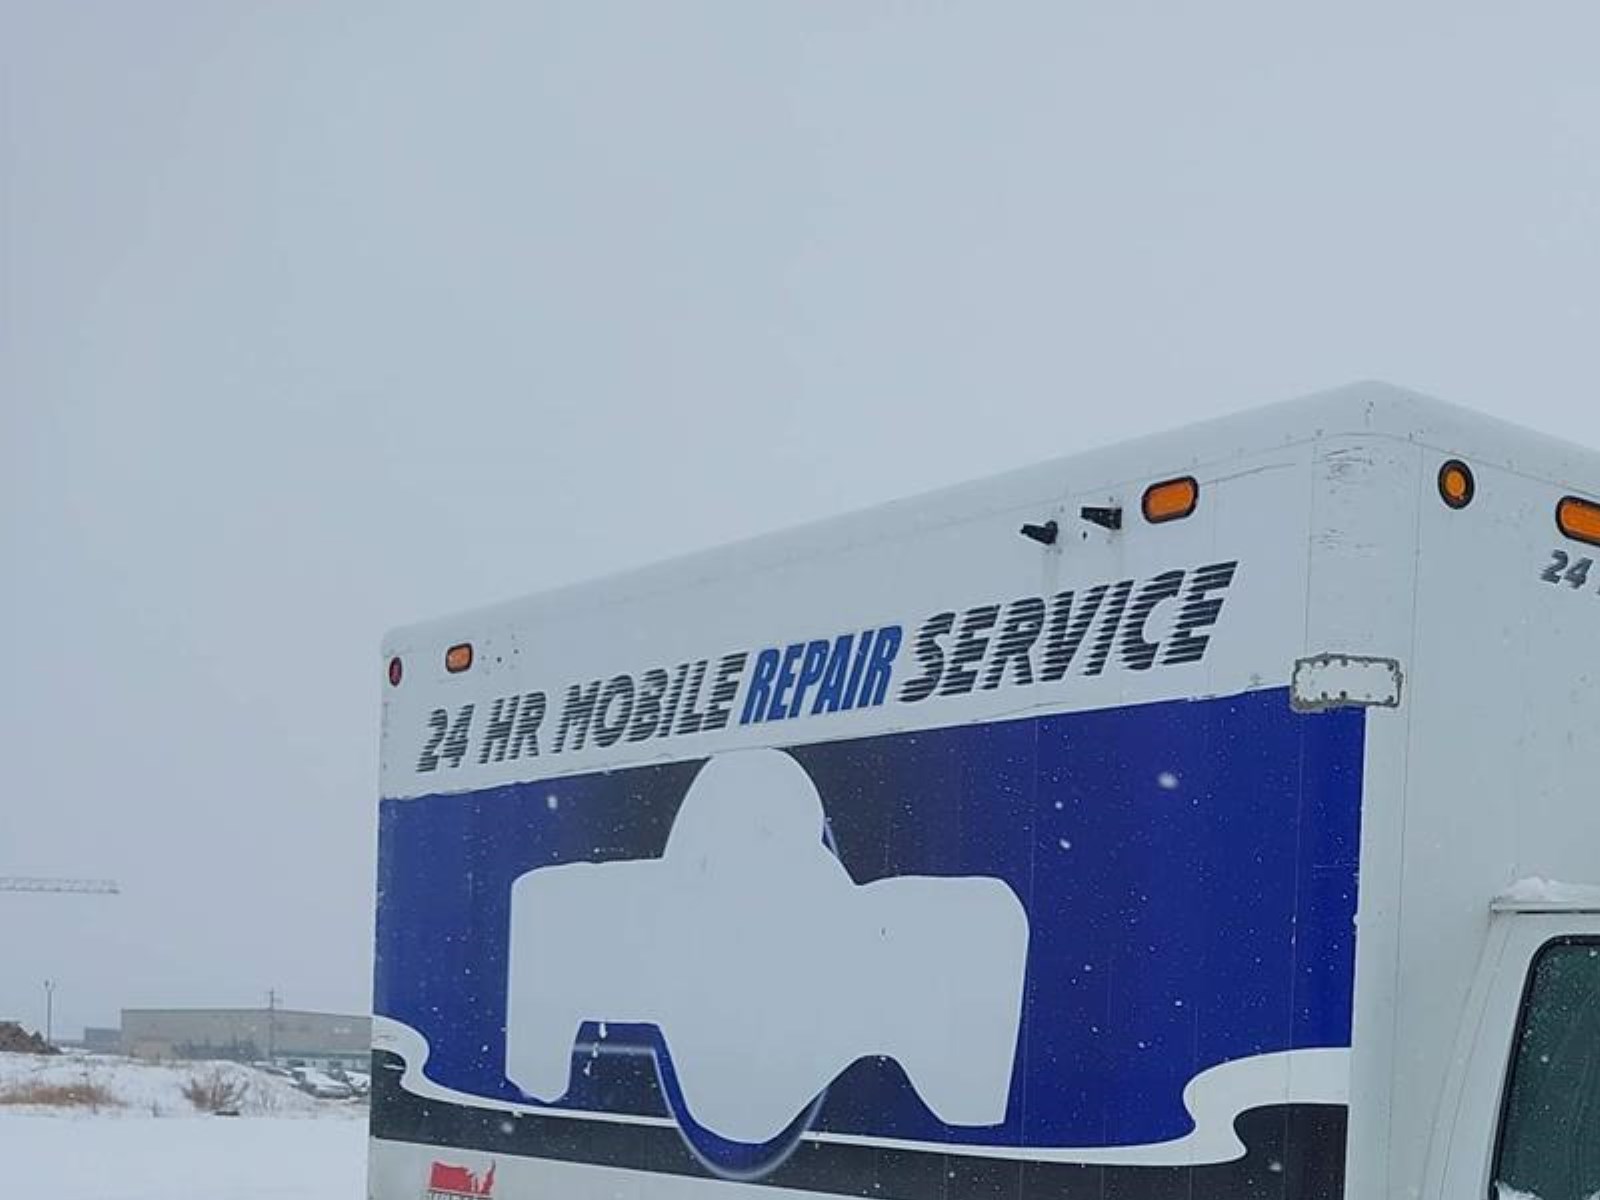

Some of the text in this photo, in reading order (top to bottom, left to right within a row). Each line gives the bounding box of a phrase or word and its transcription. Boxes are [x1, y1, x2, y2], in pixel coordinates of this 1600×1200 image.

[1540, 550, 1594, 590] 24
[416, 561, 1238, 773] 24 HR MOBILE REPAIR SERVICE
